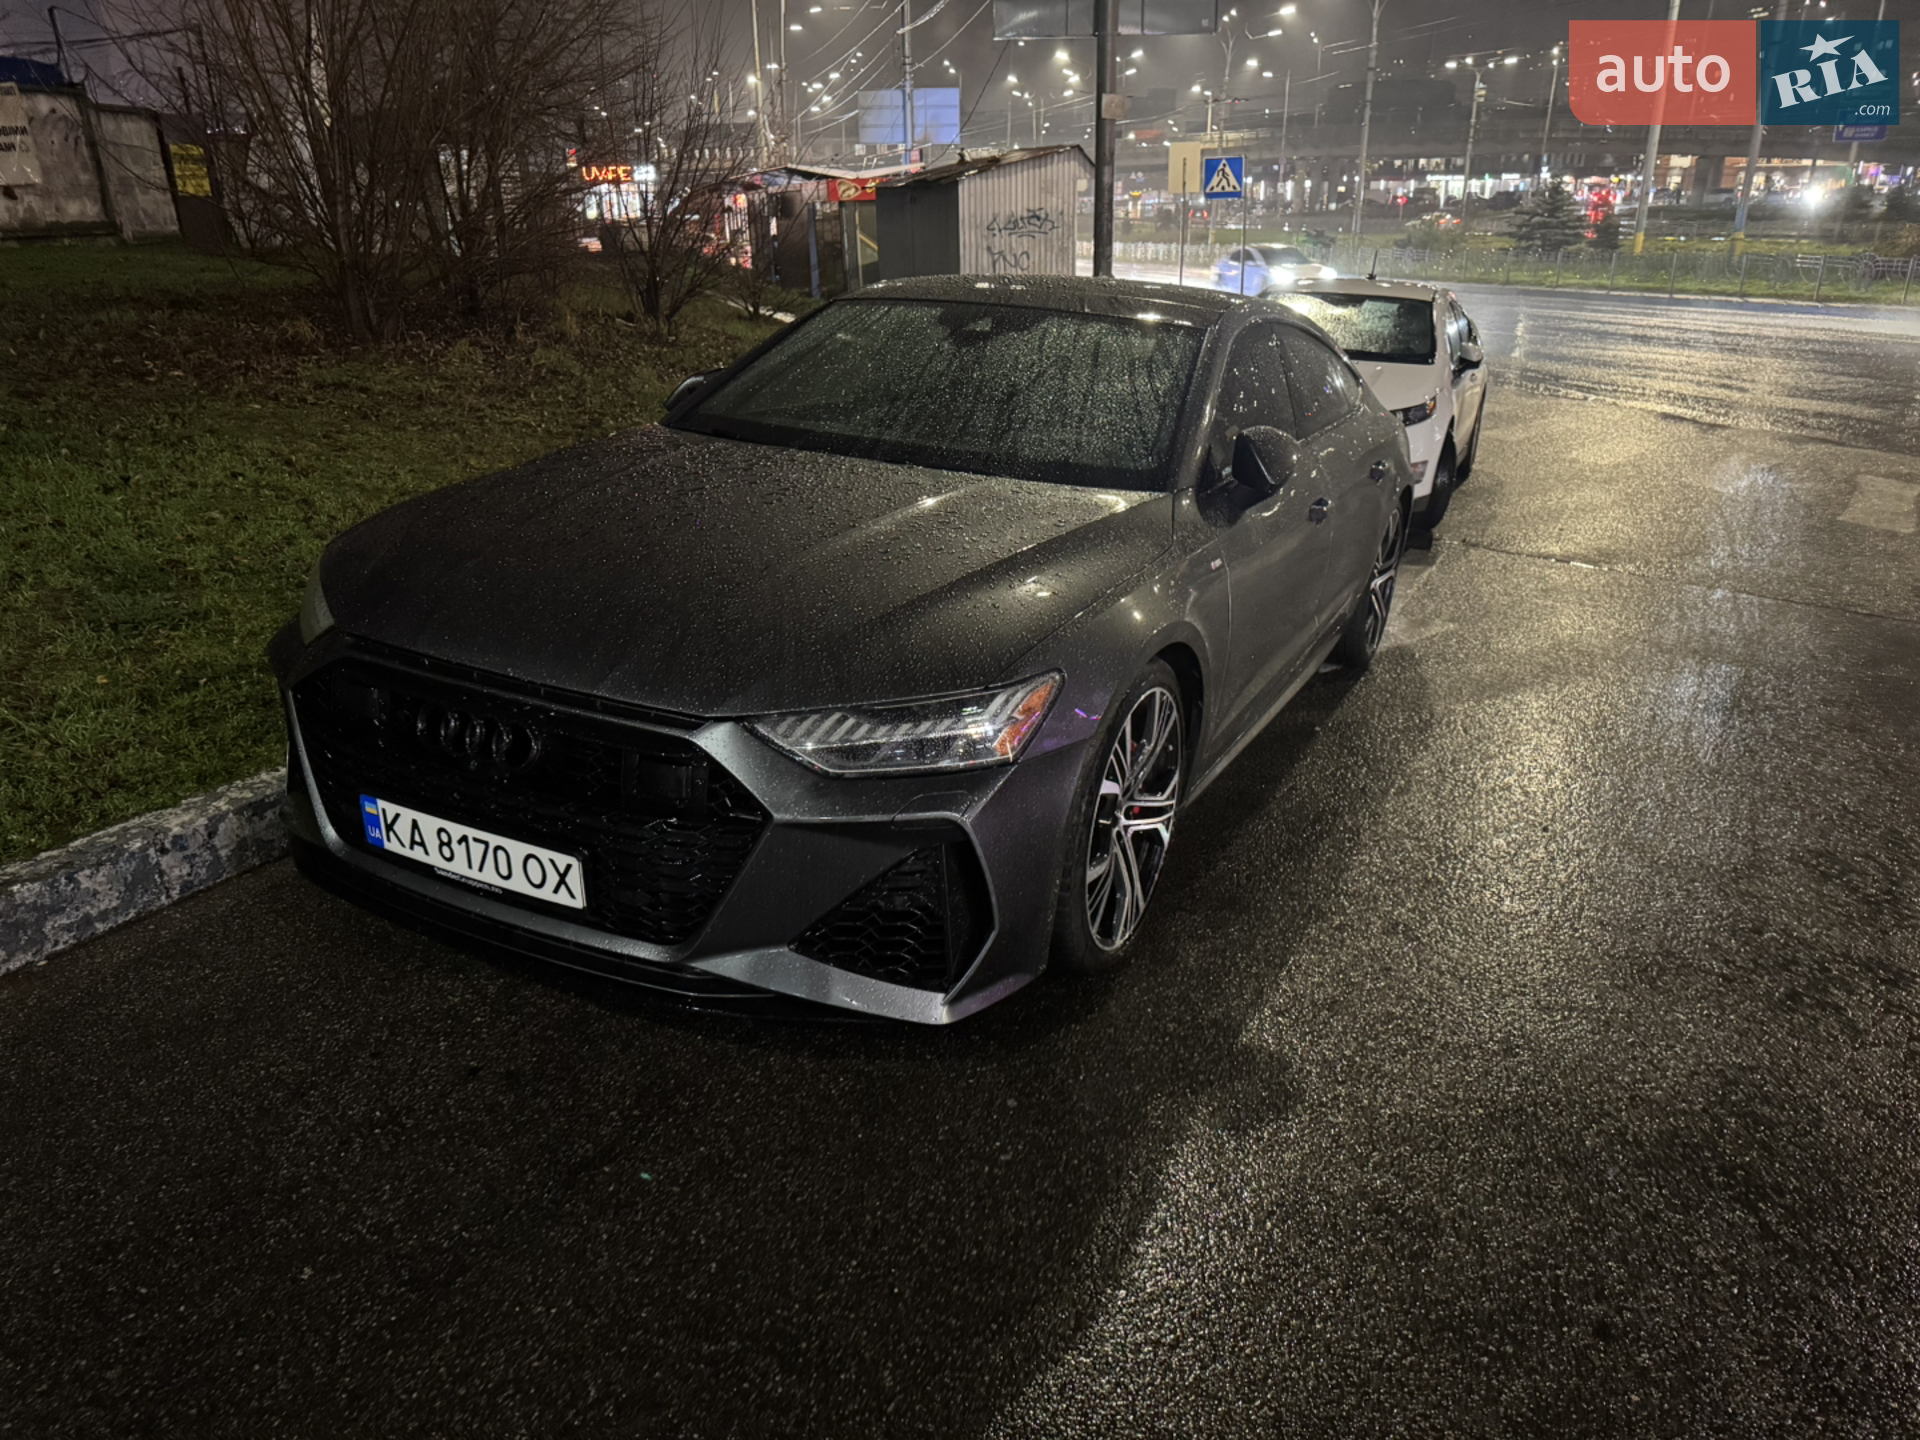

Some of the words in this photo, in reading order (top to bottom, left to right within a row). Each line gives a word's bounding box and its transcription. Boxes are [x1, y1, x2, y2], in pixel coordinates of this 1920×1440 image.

[368, 825, 382, 840] UA
[381, 807, 430, 857] KA
[436, 826, 513, 881] 8170
[522, 853, 577, 900] OX
